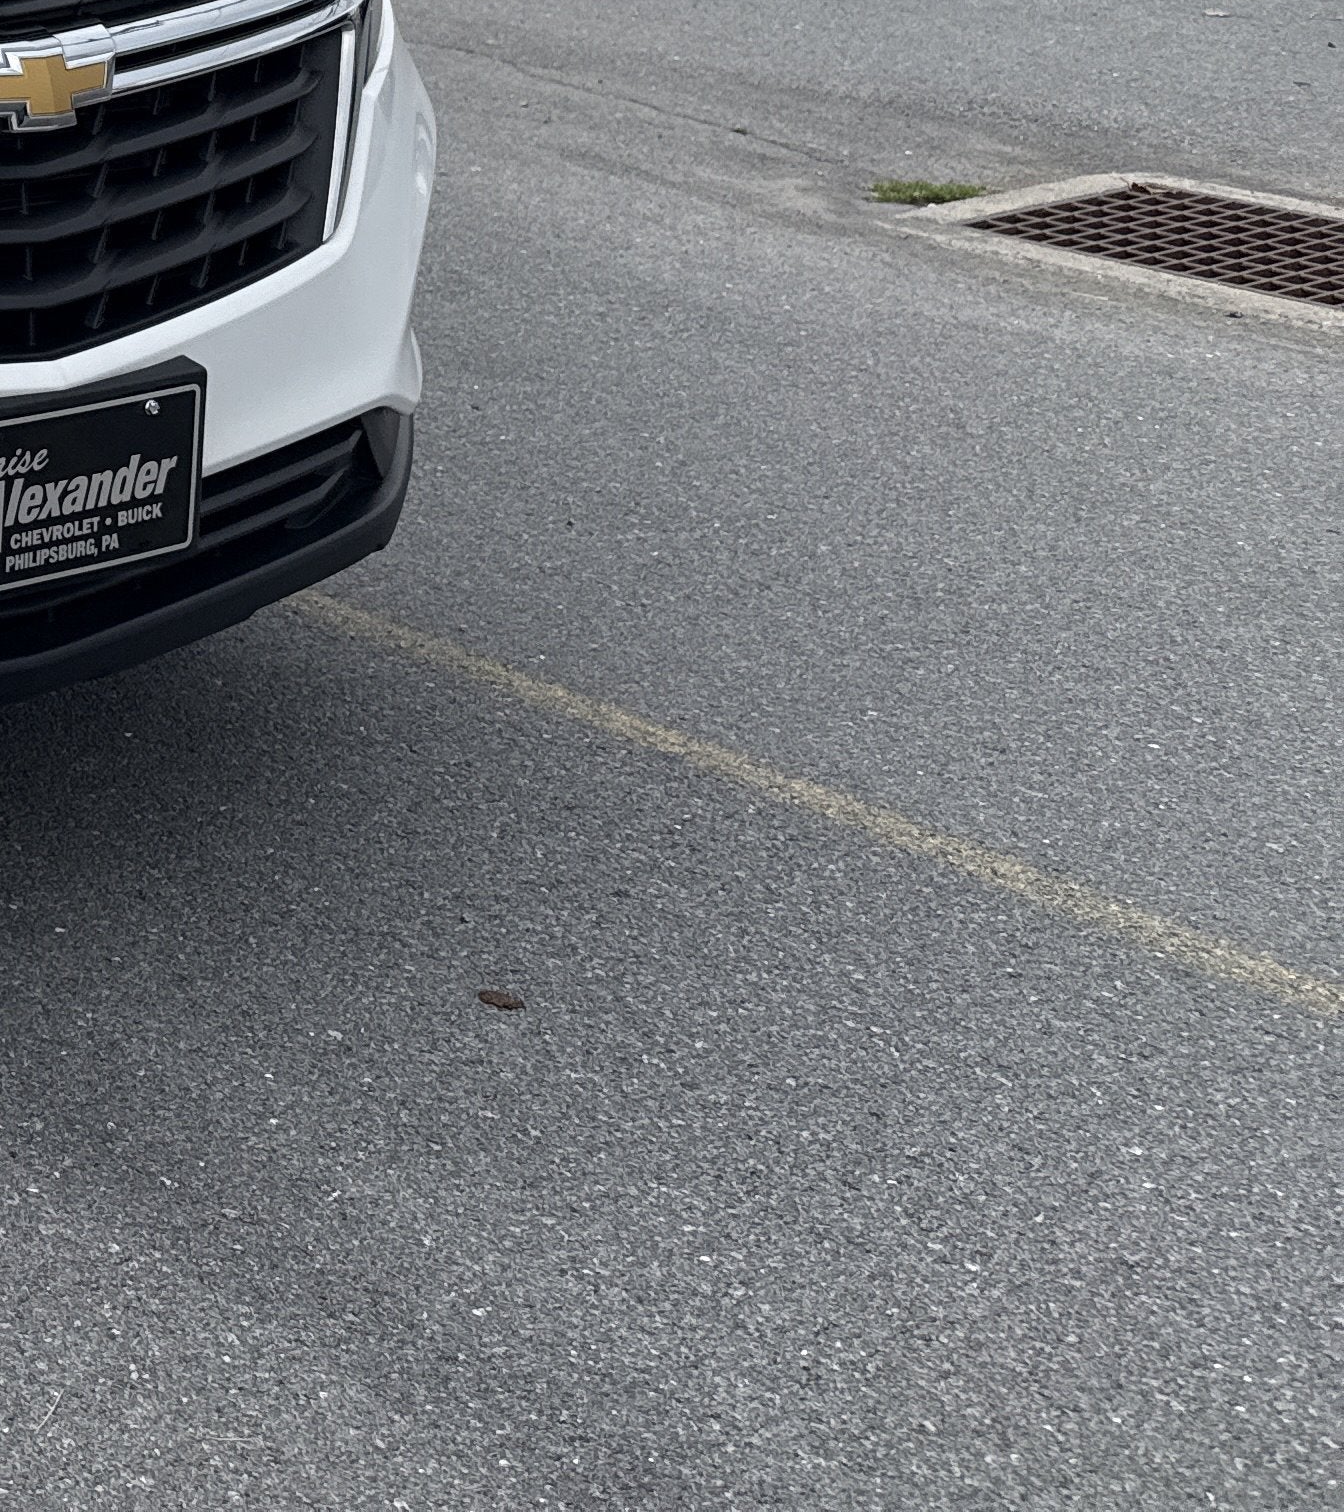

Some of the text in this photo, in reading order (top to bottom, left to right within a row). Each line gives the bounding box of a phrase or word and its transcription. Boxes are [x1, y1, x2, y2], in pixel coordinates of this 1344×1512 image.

[9, 502, 164, 550] CHEVROLET BUICK
[5, 532, 120, 573] PHILIPSBURG, PA
